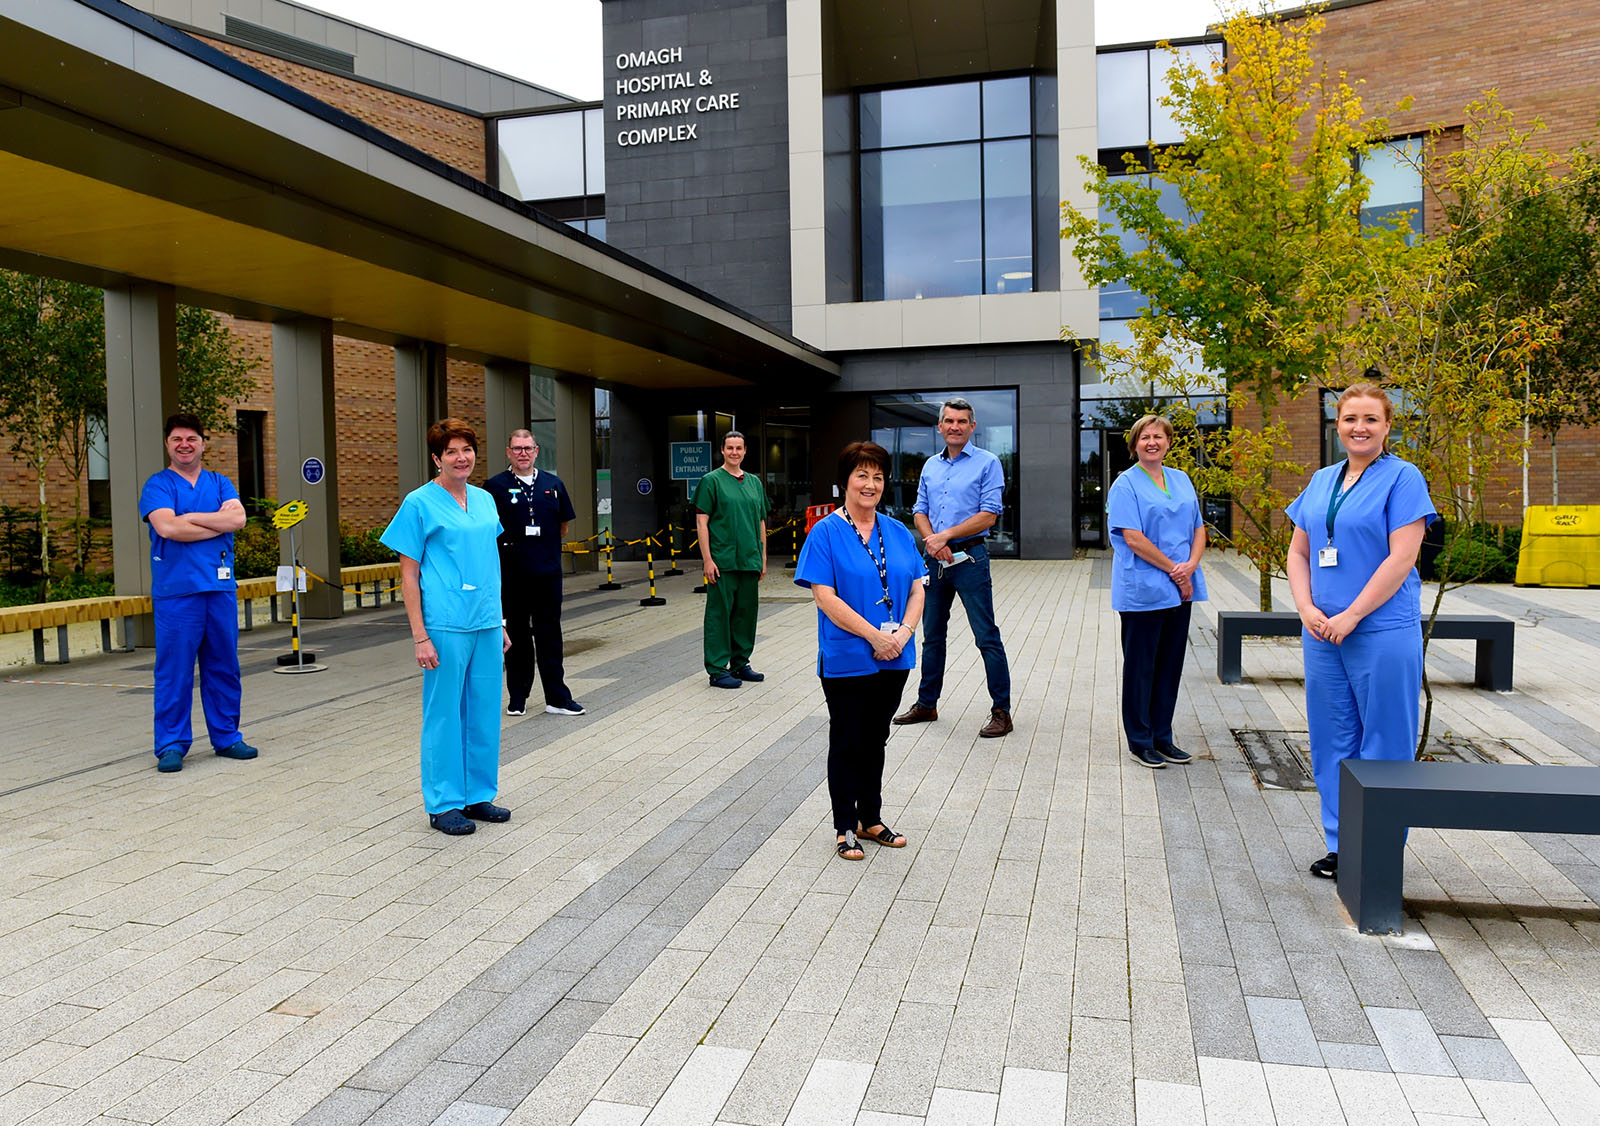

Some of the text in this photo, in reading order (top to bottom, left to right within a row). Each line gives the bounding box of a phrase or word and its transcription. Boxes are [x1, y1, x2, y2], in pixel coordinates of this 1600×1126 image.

[616, 47, 682, 69] OMAGH
[616, 69, 713, 95] HOSPITAL &
[617, 93, 740, 121] PRIMARY CARE
[617, 124, 697, 146] COMPLEX
[680, 446, 703, 454] PUBLIC
[675, 465, 709, 473] ENTRANCE
